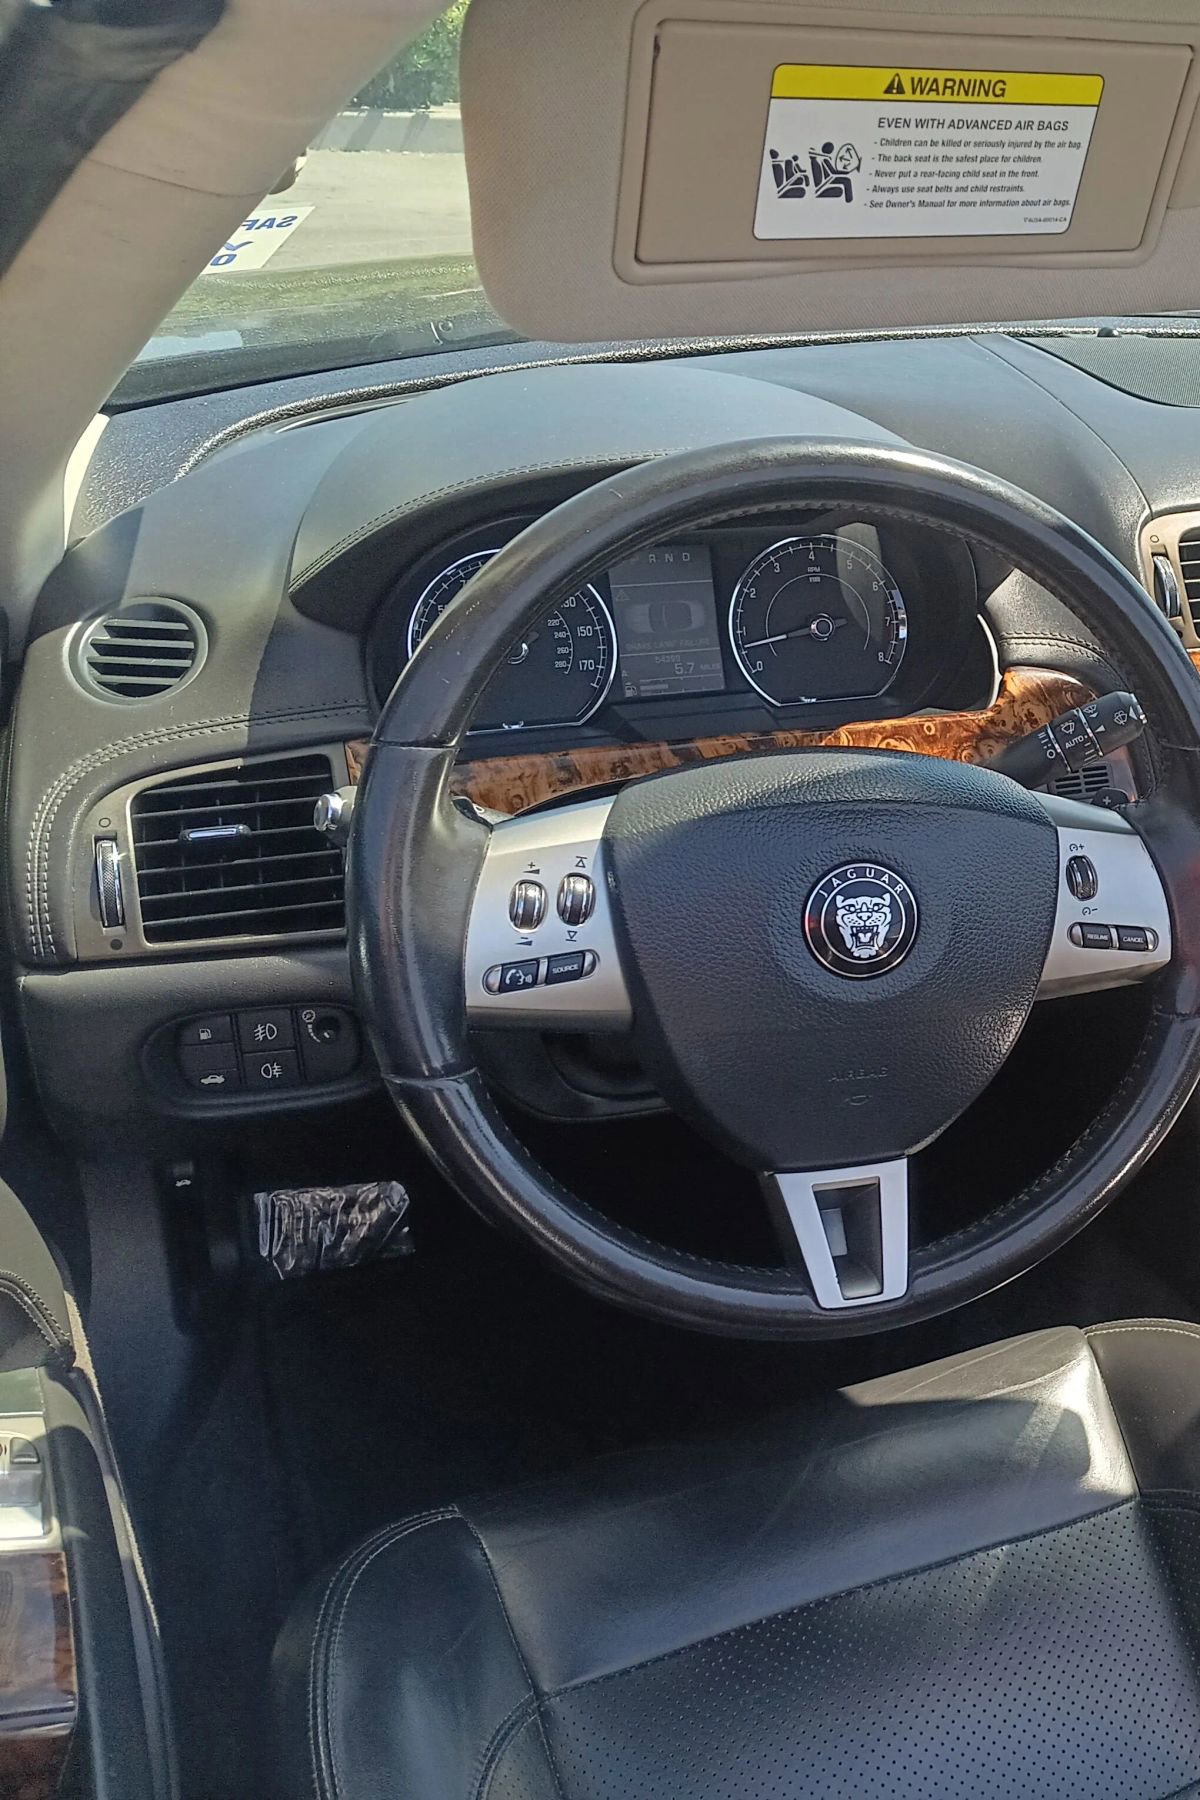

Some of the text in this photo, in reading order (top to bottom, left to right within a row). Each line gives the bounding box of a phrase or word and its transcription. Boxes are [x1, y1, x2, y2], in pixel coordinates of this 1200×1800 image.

[910, 77, 1007, 98] WARNING
[878, 117, 1069, 131] EVEN WITH ADVANCED AIR BAGS
[880, 138, 912, 147] Children
[930, 139, 939, 147] be
[941, 139, 962, 147] killed
[973, 140, 1006, 149] seriously
[1007, 140, 1033, 149] injured
[1034, 140, 1042, 149] by
[1044, 140, 1055, 148] the
[1057, 140, 1066, 148] air
[878, 153, 892, 162] The
[894, 154, 912, 162] back
[914, 154, 931, 162] seat
[933, 154, 939, 162] is
[941, 154, 953, 162] the
[955, 154, 978, 163] safest
[979, 155, 1000, 164] place
[1001, 155, 1012, 163] for
[874, 169, 896, 178] Never
[898, 170, 912, 179] put
[920, 169, 960, 179] rear-facing
[962, 170, 981, 178] child
[981, 170, 998, 178] seat
[999, 170, 1006, 178] in
[1007, 170, 1019, 178] the
[1021, 170, 1040, 178] front.
[872, 185, 899, 194] Always
[916, 185, 933, 193] seat
[935, 185, 953, 193] belts
[954, 185, 969, 193] and
[970, 185, 988, 193] child
[989, 184, 1024, 192] restraints.
[869, 199, 1071, 208] See Owner's Manual for more information about air bags.
[648, 552, 690, 563] R N D
[808, 551, 815, 561] 4
[773, 563, 780, 573] 3
[846, 559, 853, 570] 5
[872, 581, 879, 591] 6
[749, 588, 757, 598] 2
[547, 619, 560, 627] 220
[884, 617, 890, 626] 7
[554, 631, 567, 639] 240
[577, 625, 593, 637] 150
[878, 651, 884, 661] 8
[579, 660, 595, 671] 170
[674, 662, 695, 675] 5.7
[756, 660, 763, 671] 0
[1065, 734, 1084, 750] AUTO
[818, 867, 904, 898] JAGUAR
[552, 963, 579, 974] SOURCE
